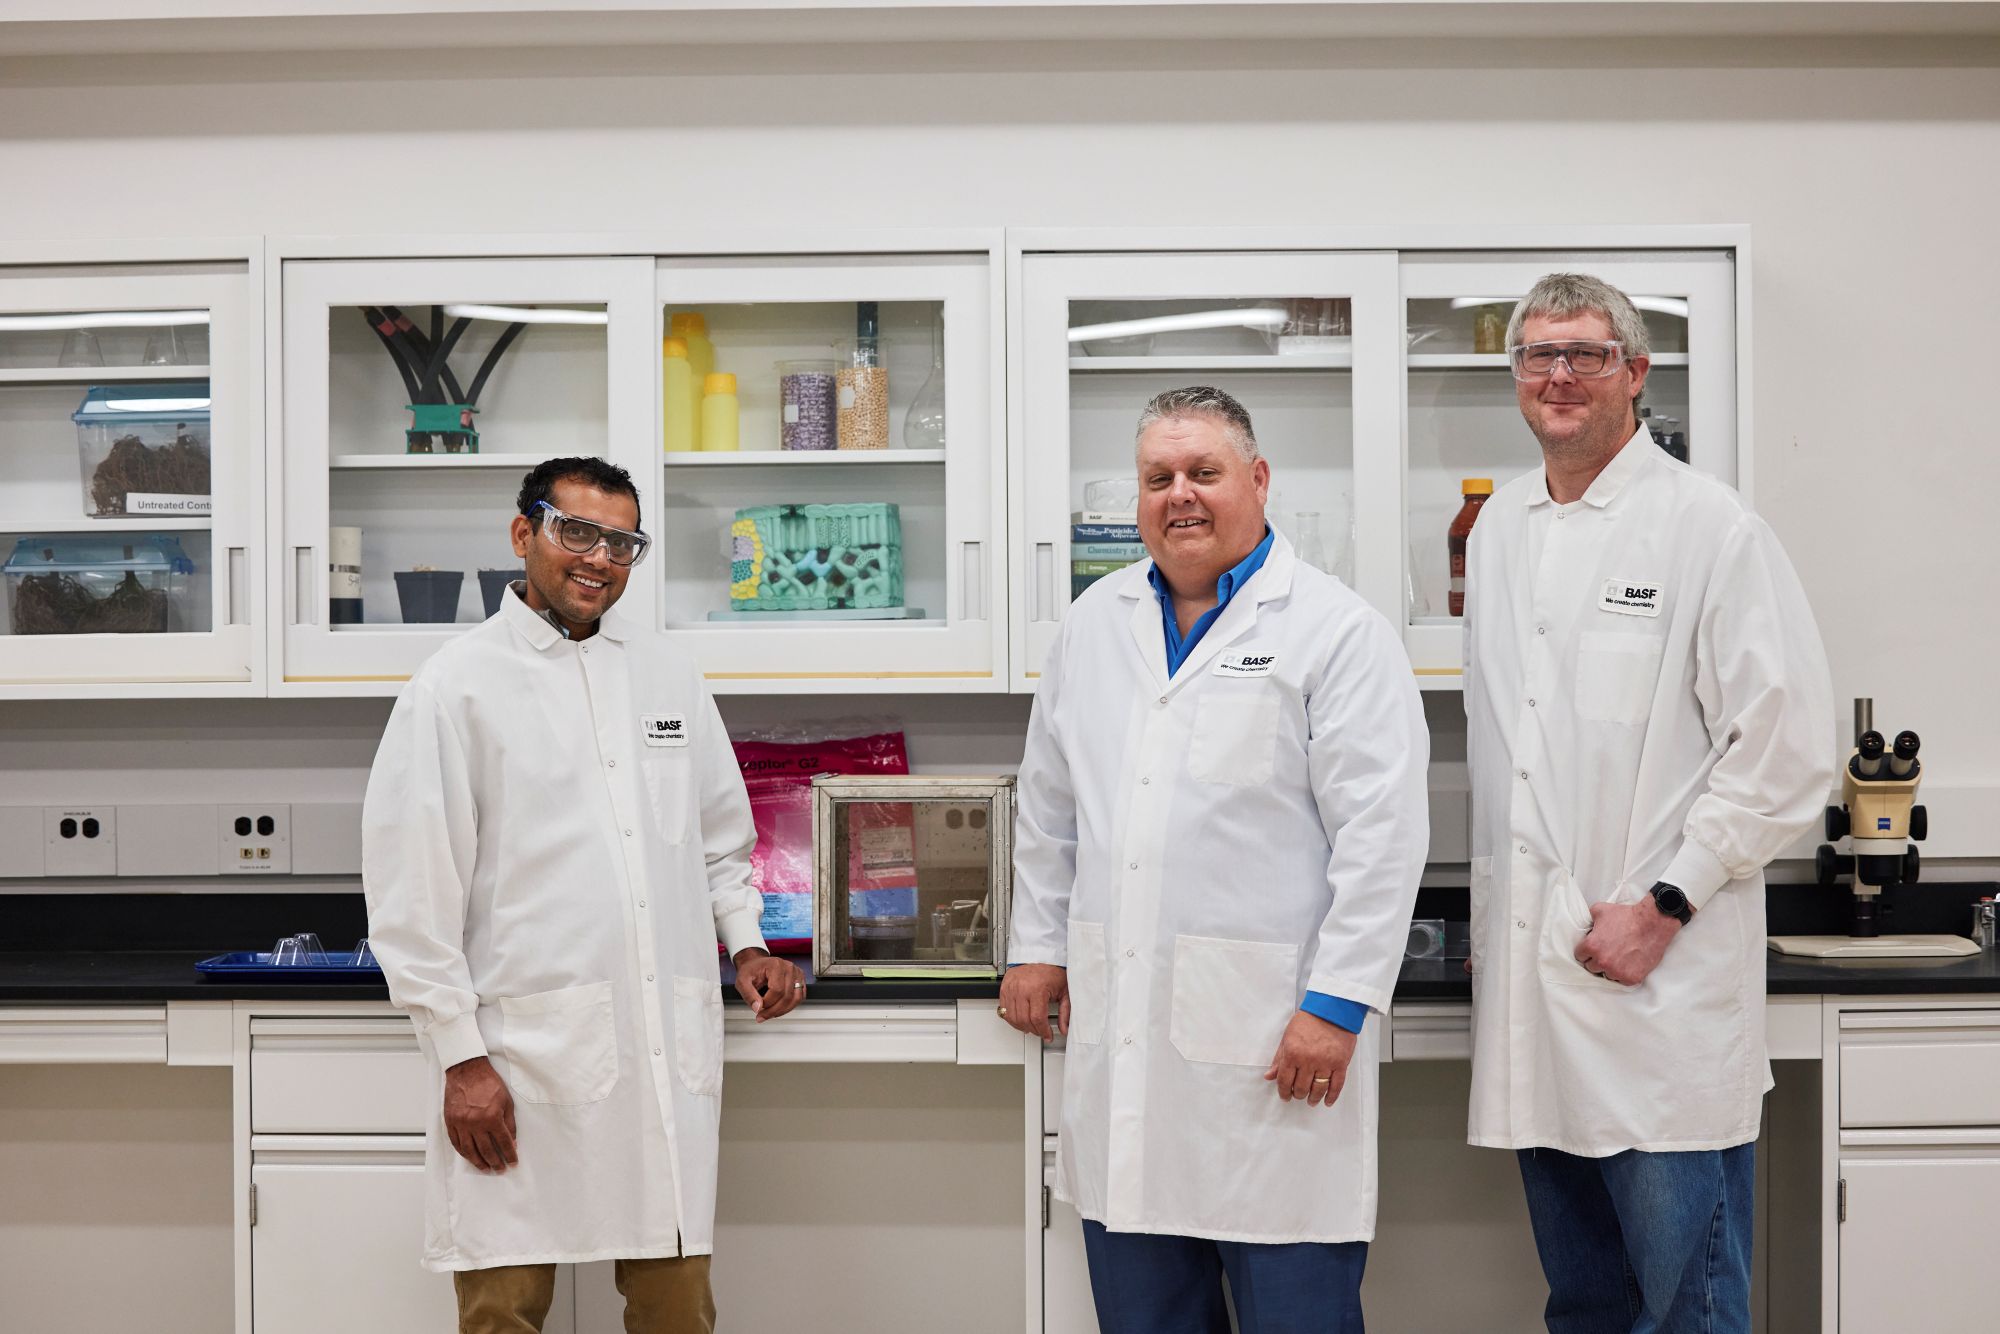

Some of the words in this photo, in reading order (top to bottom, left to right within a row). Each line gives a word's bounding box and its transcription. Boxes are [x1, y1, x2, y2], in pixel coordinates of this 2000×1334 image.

[138, 501, 184, 510] Untreated
[1088, 546, 1128, 555] Chemistry
[1625, 587, 1657, 599] BASF
[1241, 656, 1275, 665] BASF
[656, 720, 682, 731] BASF
[799, 758, 819, 769] G2
